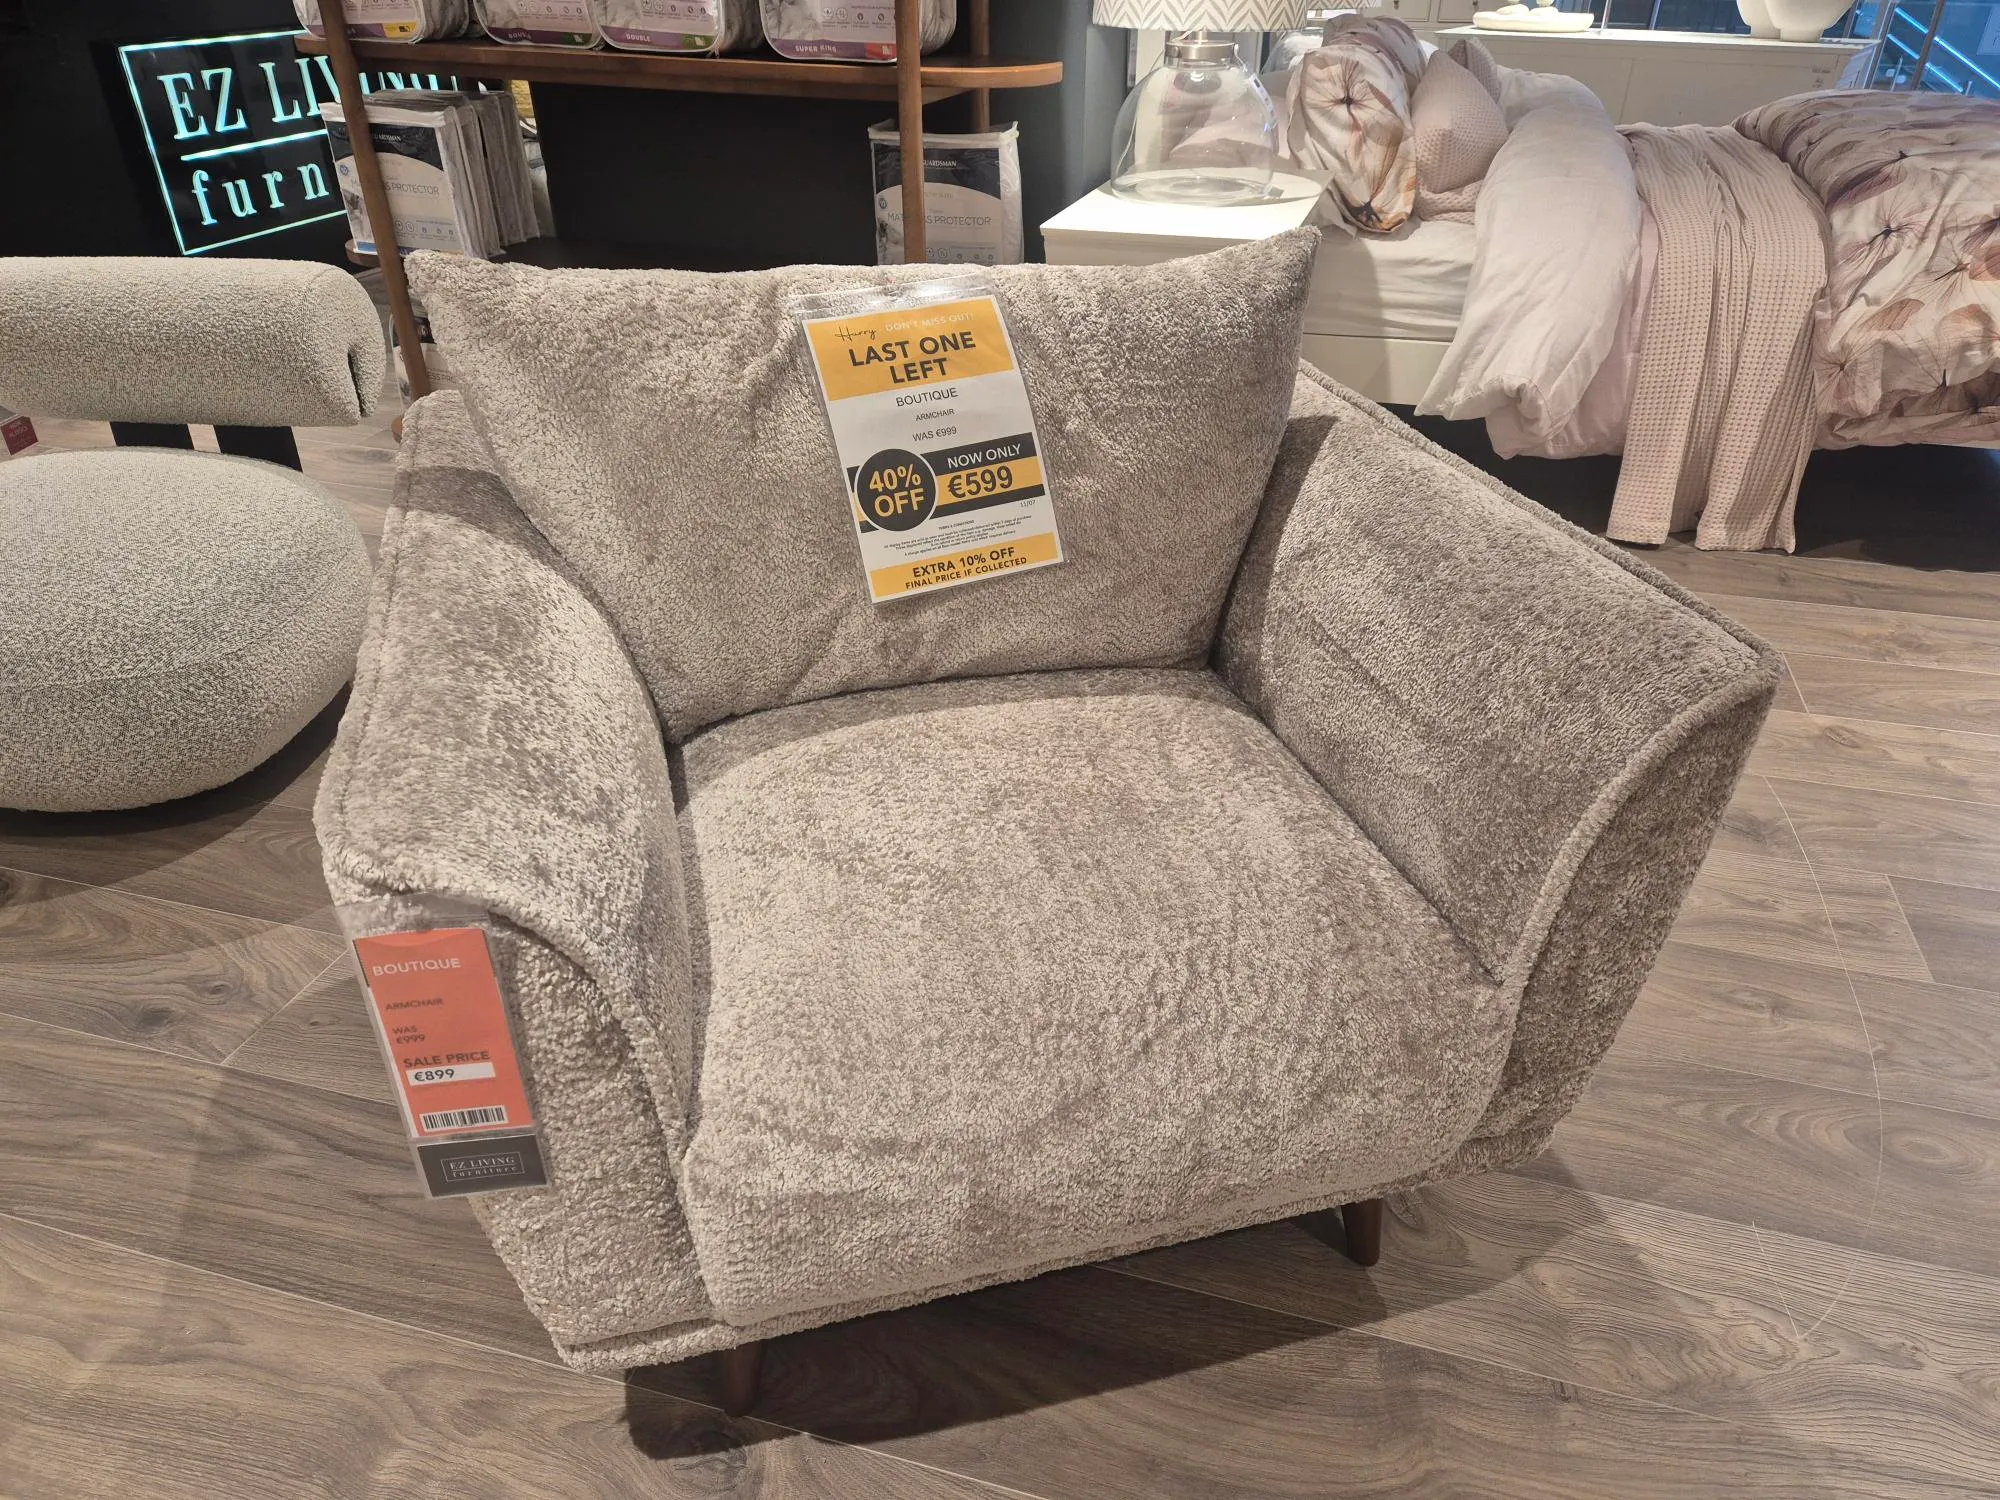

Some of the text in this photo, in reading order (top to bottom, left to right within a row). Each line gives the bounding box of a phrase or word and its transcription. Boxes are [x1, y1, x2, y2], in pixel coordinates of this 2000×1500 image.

[626, 33, 652, 43] DOUBLE
[795, 44, 818, 53] SUPER
[157, 67, 249, 140] EZ
[392, 182, 440, 196] PROTECTOR
[934, 215, 992, 226] PROTECTOR
[834, 326, 877, 343] Hurry
[921, 316, 945, 329] MISS
[848, 331, 977, 367] LAST ONE
[890, 357, 950, 384] LEFT
[895, 387, 959, 407] BOUTIQUE
[915, 408, 956, 422] ARMCHAIR
[912, 426, 958, 443] WAS €999
[947, 443, 1022, 470] NOW ONLY
[869, 463, 922, 494] 40%
[947, 465, 1014, 499] €599
[874, 487, 925, 518] OFF
[912, 546, 1016, 578] EXTRA 10% OFF
[905, 557, 1028, 590] FINAL PRICE IF COLLECTED
[372, 958, 461, 977] BOUTIQUE
[385, 997, 444, 1012] ARMCHAIR
[392, 1024, 418, 1035] WAS
[395, 1033, 427, 1045] €999
[403, 1050, 490, 1069] SALE PRICE
[414, 1067, 455, 1083] €899
[449, 1156, 515, 1170] EZ LIVING
